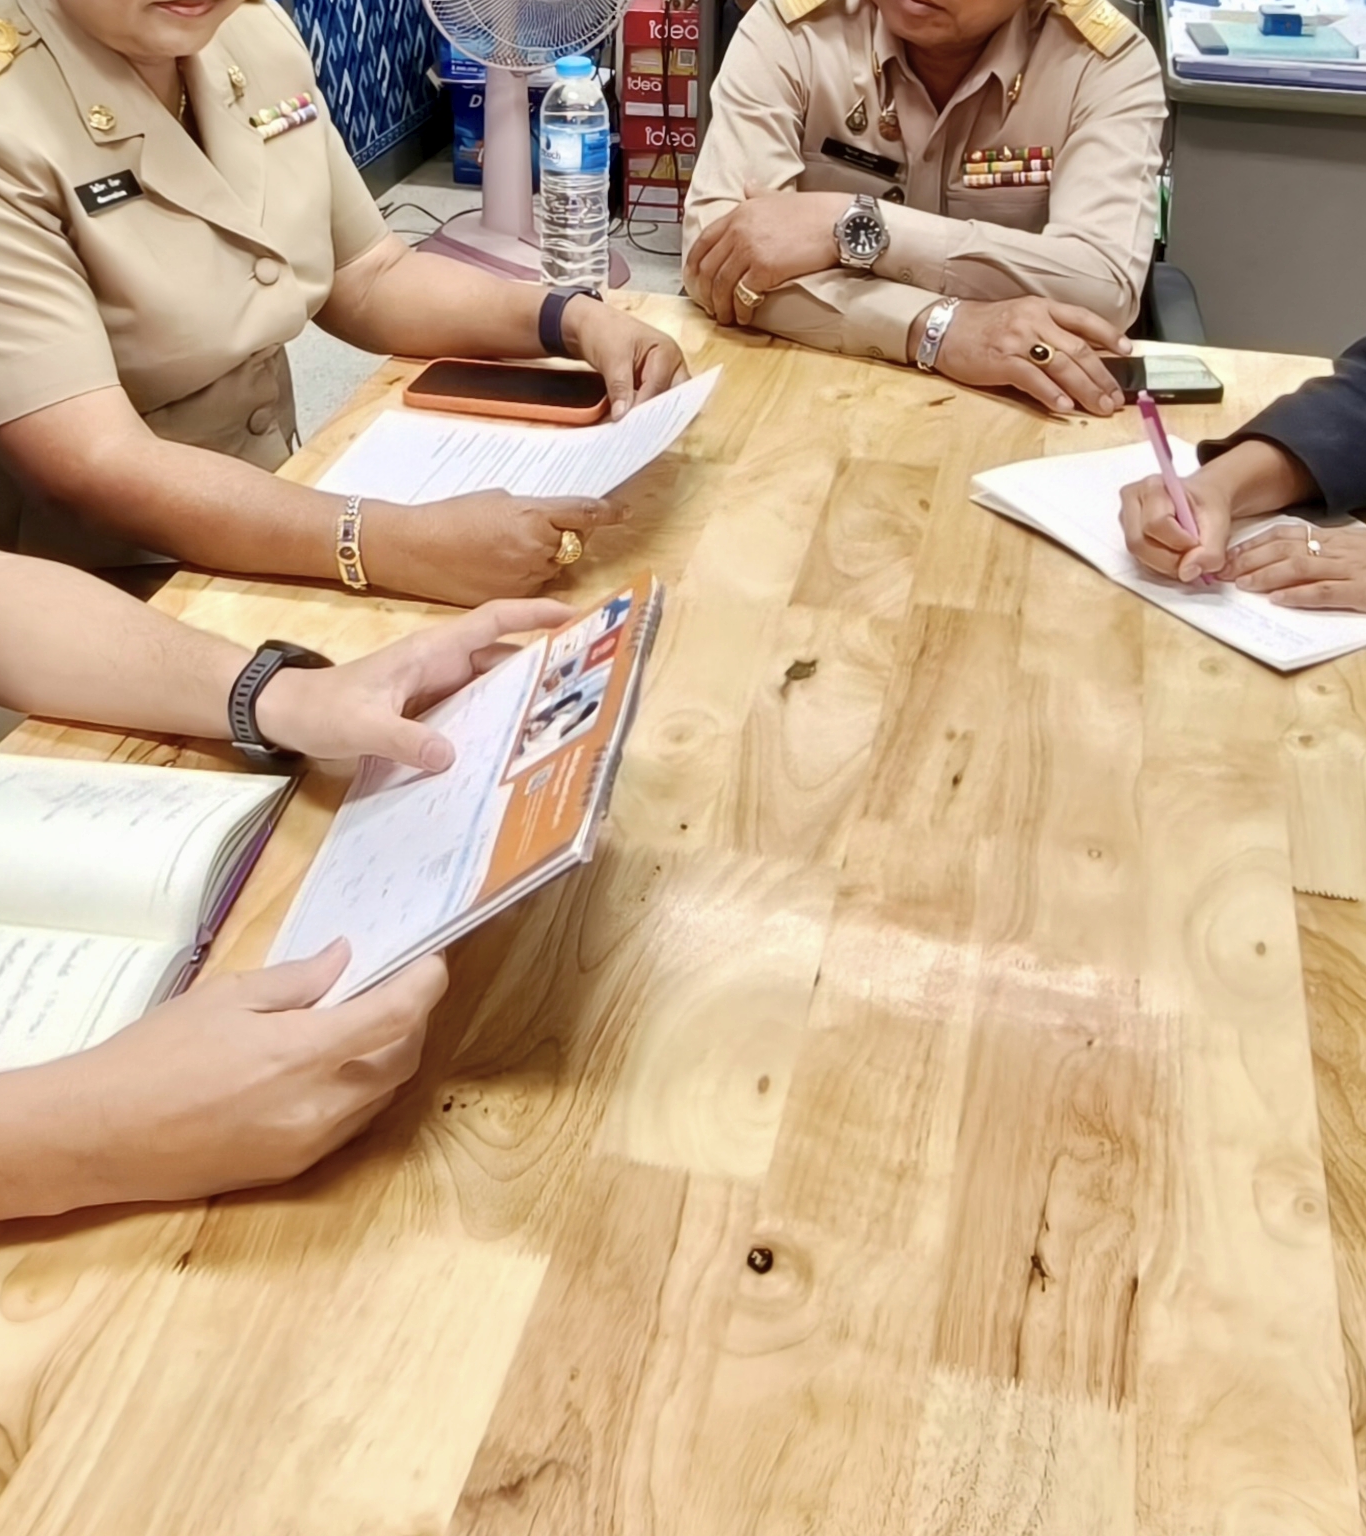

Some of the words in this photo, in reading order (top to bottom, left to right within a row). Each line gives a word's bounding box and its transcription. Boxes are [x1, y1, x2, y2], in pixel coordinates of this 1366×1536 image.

[648, 19, 699, 41] idea
[626, 76, 663, 93] idea
[645, 125, 697, 148] idea
